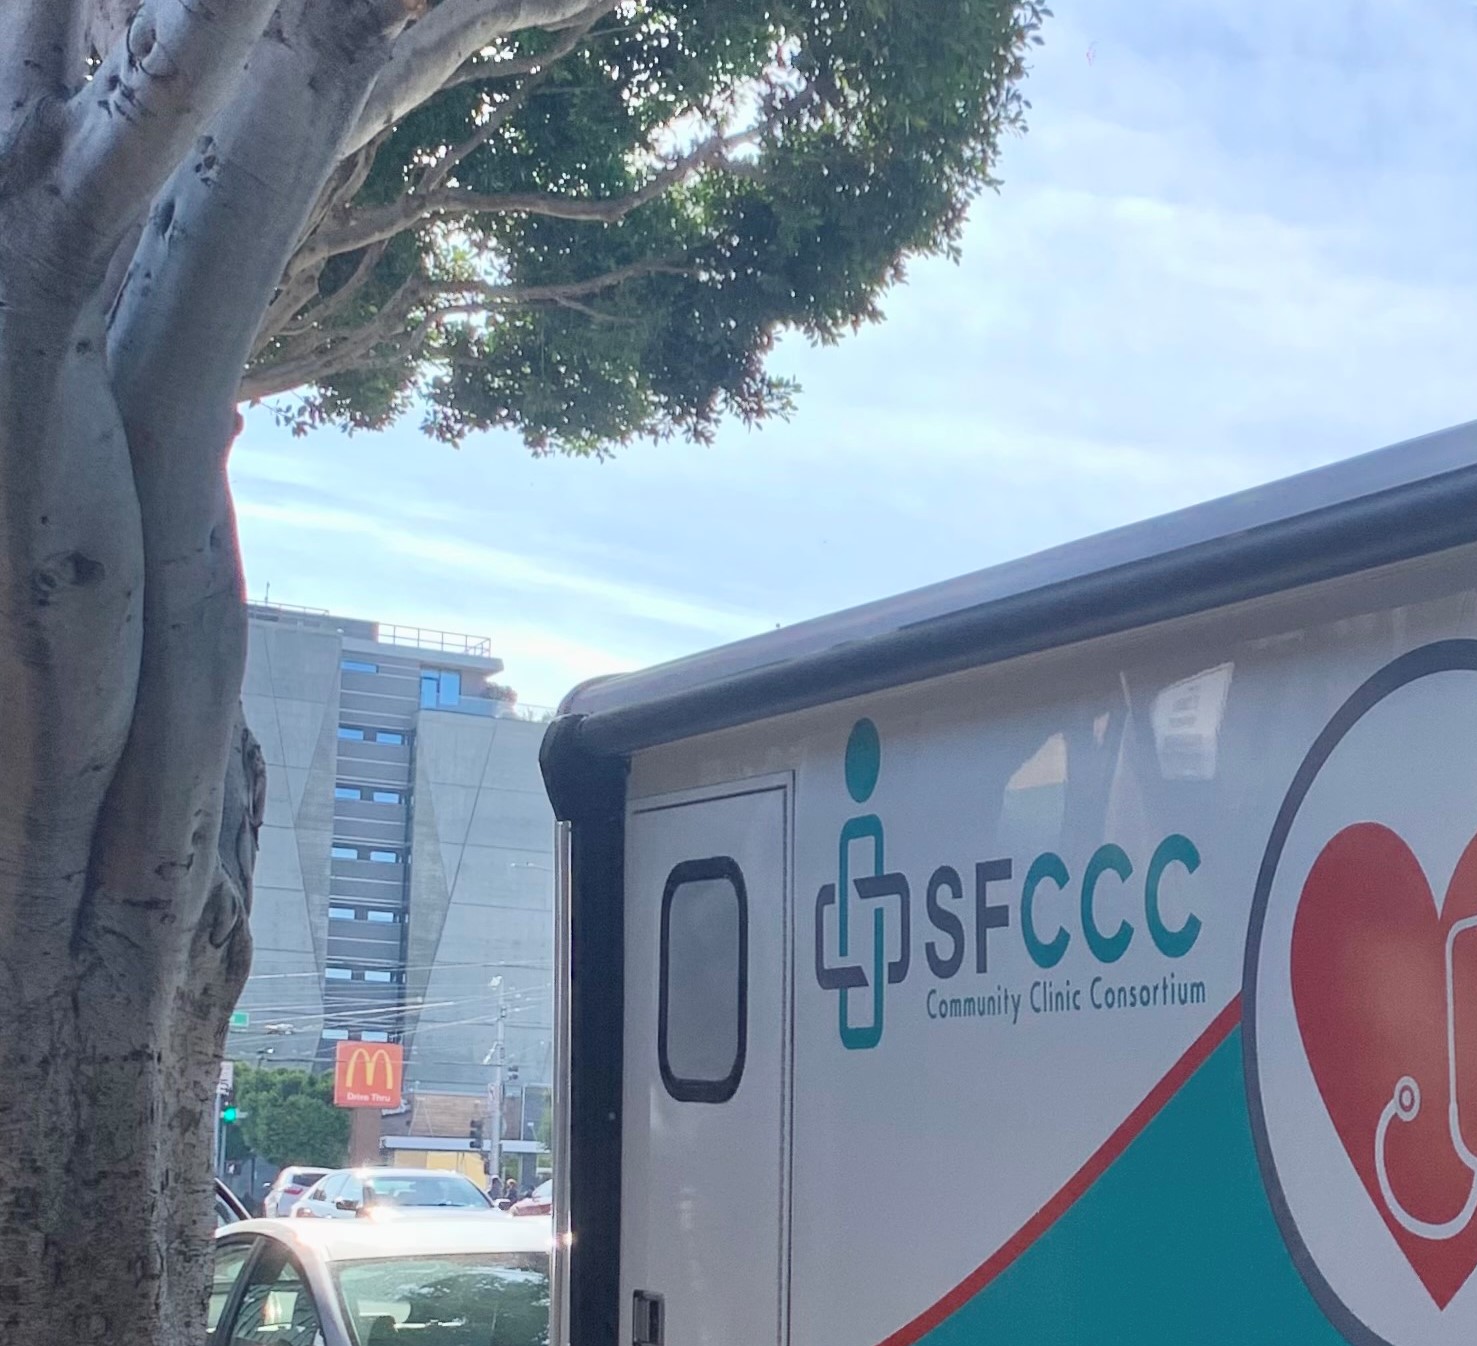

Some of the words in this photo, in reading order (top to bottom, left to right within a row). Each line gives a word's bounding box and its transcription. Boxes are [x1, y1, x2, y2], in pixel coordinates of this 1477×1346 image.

[924, 833, 1203, 980] SFCCC
[926, 985, 1022, 1025] Community
[1030, 980, 1082, 1014] Clinic
[1090, 972, 1207, 1010] Consortium
[346, 1091, 370, 1101] Drive
[370, 1092, 391, 1102] Thru
